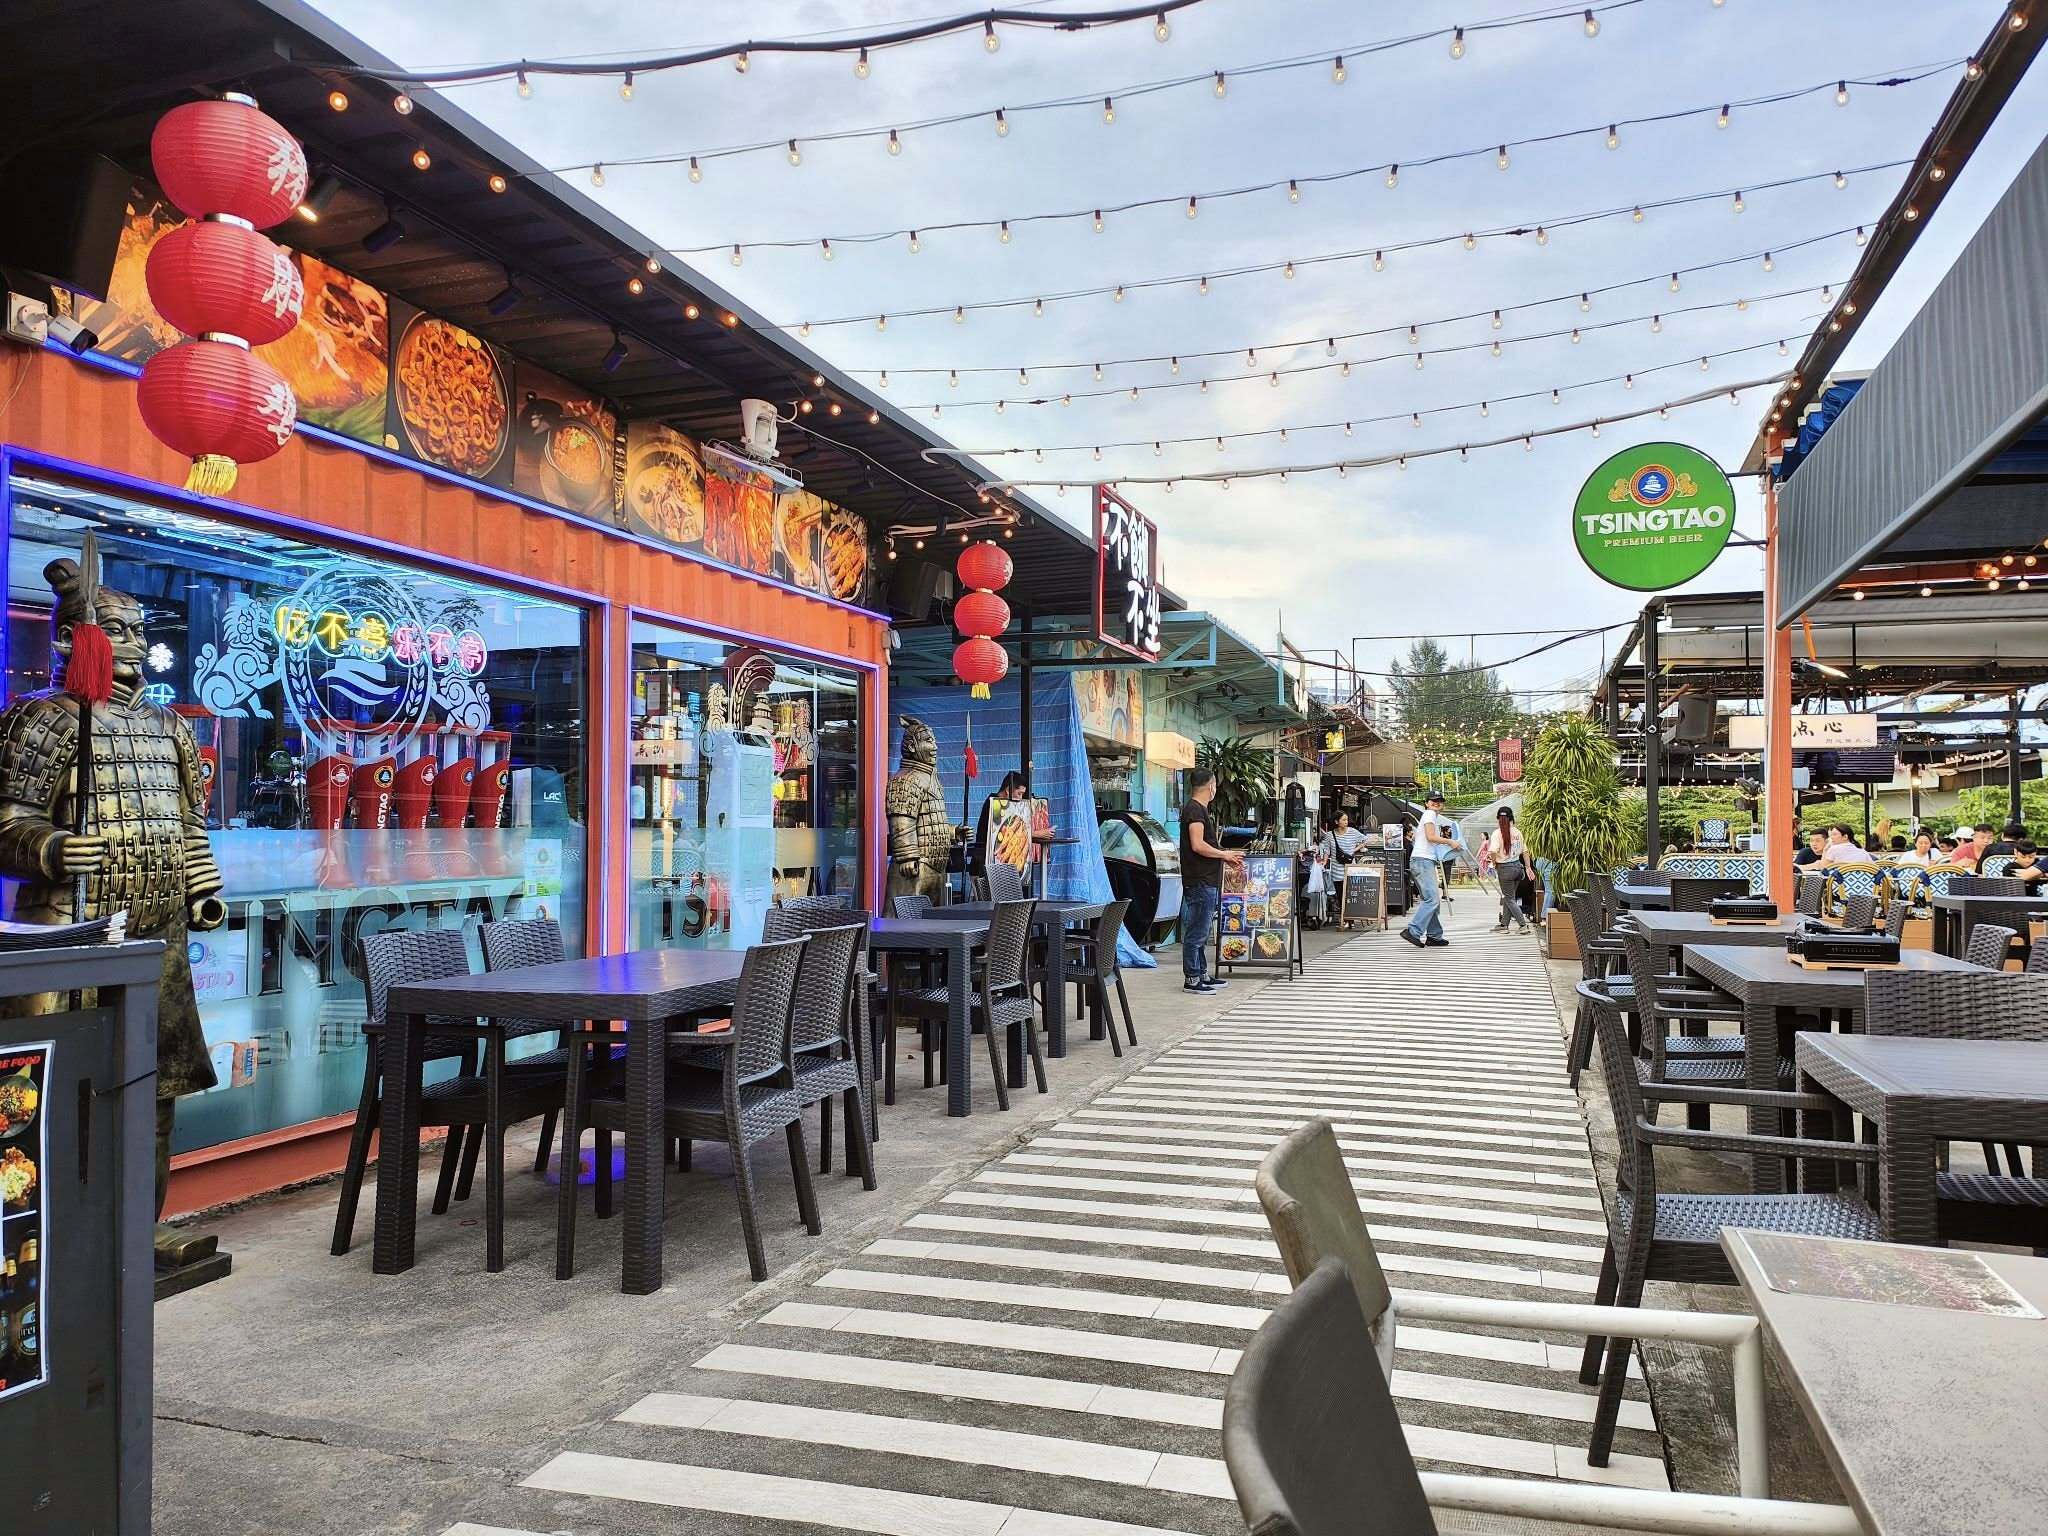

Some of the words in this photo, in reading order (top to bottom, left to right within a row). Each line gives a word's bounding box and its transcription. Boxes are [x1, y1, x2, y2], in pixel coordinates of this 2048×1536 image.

[1581, 506, 1726, 535] TSINGTAO
[1604, 536, 1665, 547] PREMIUM
[1669, 533, 1704, 544] BEER
[1793, 720, 1842, 737] 点心
[11, 1056, 41, 1068] FOOD
